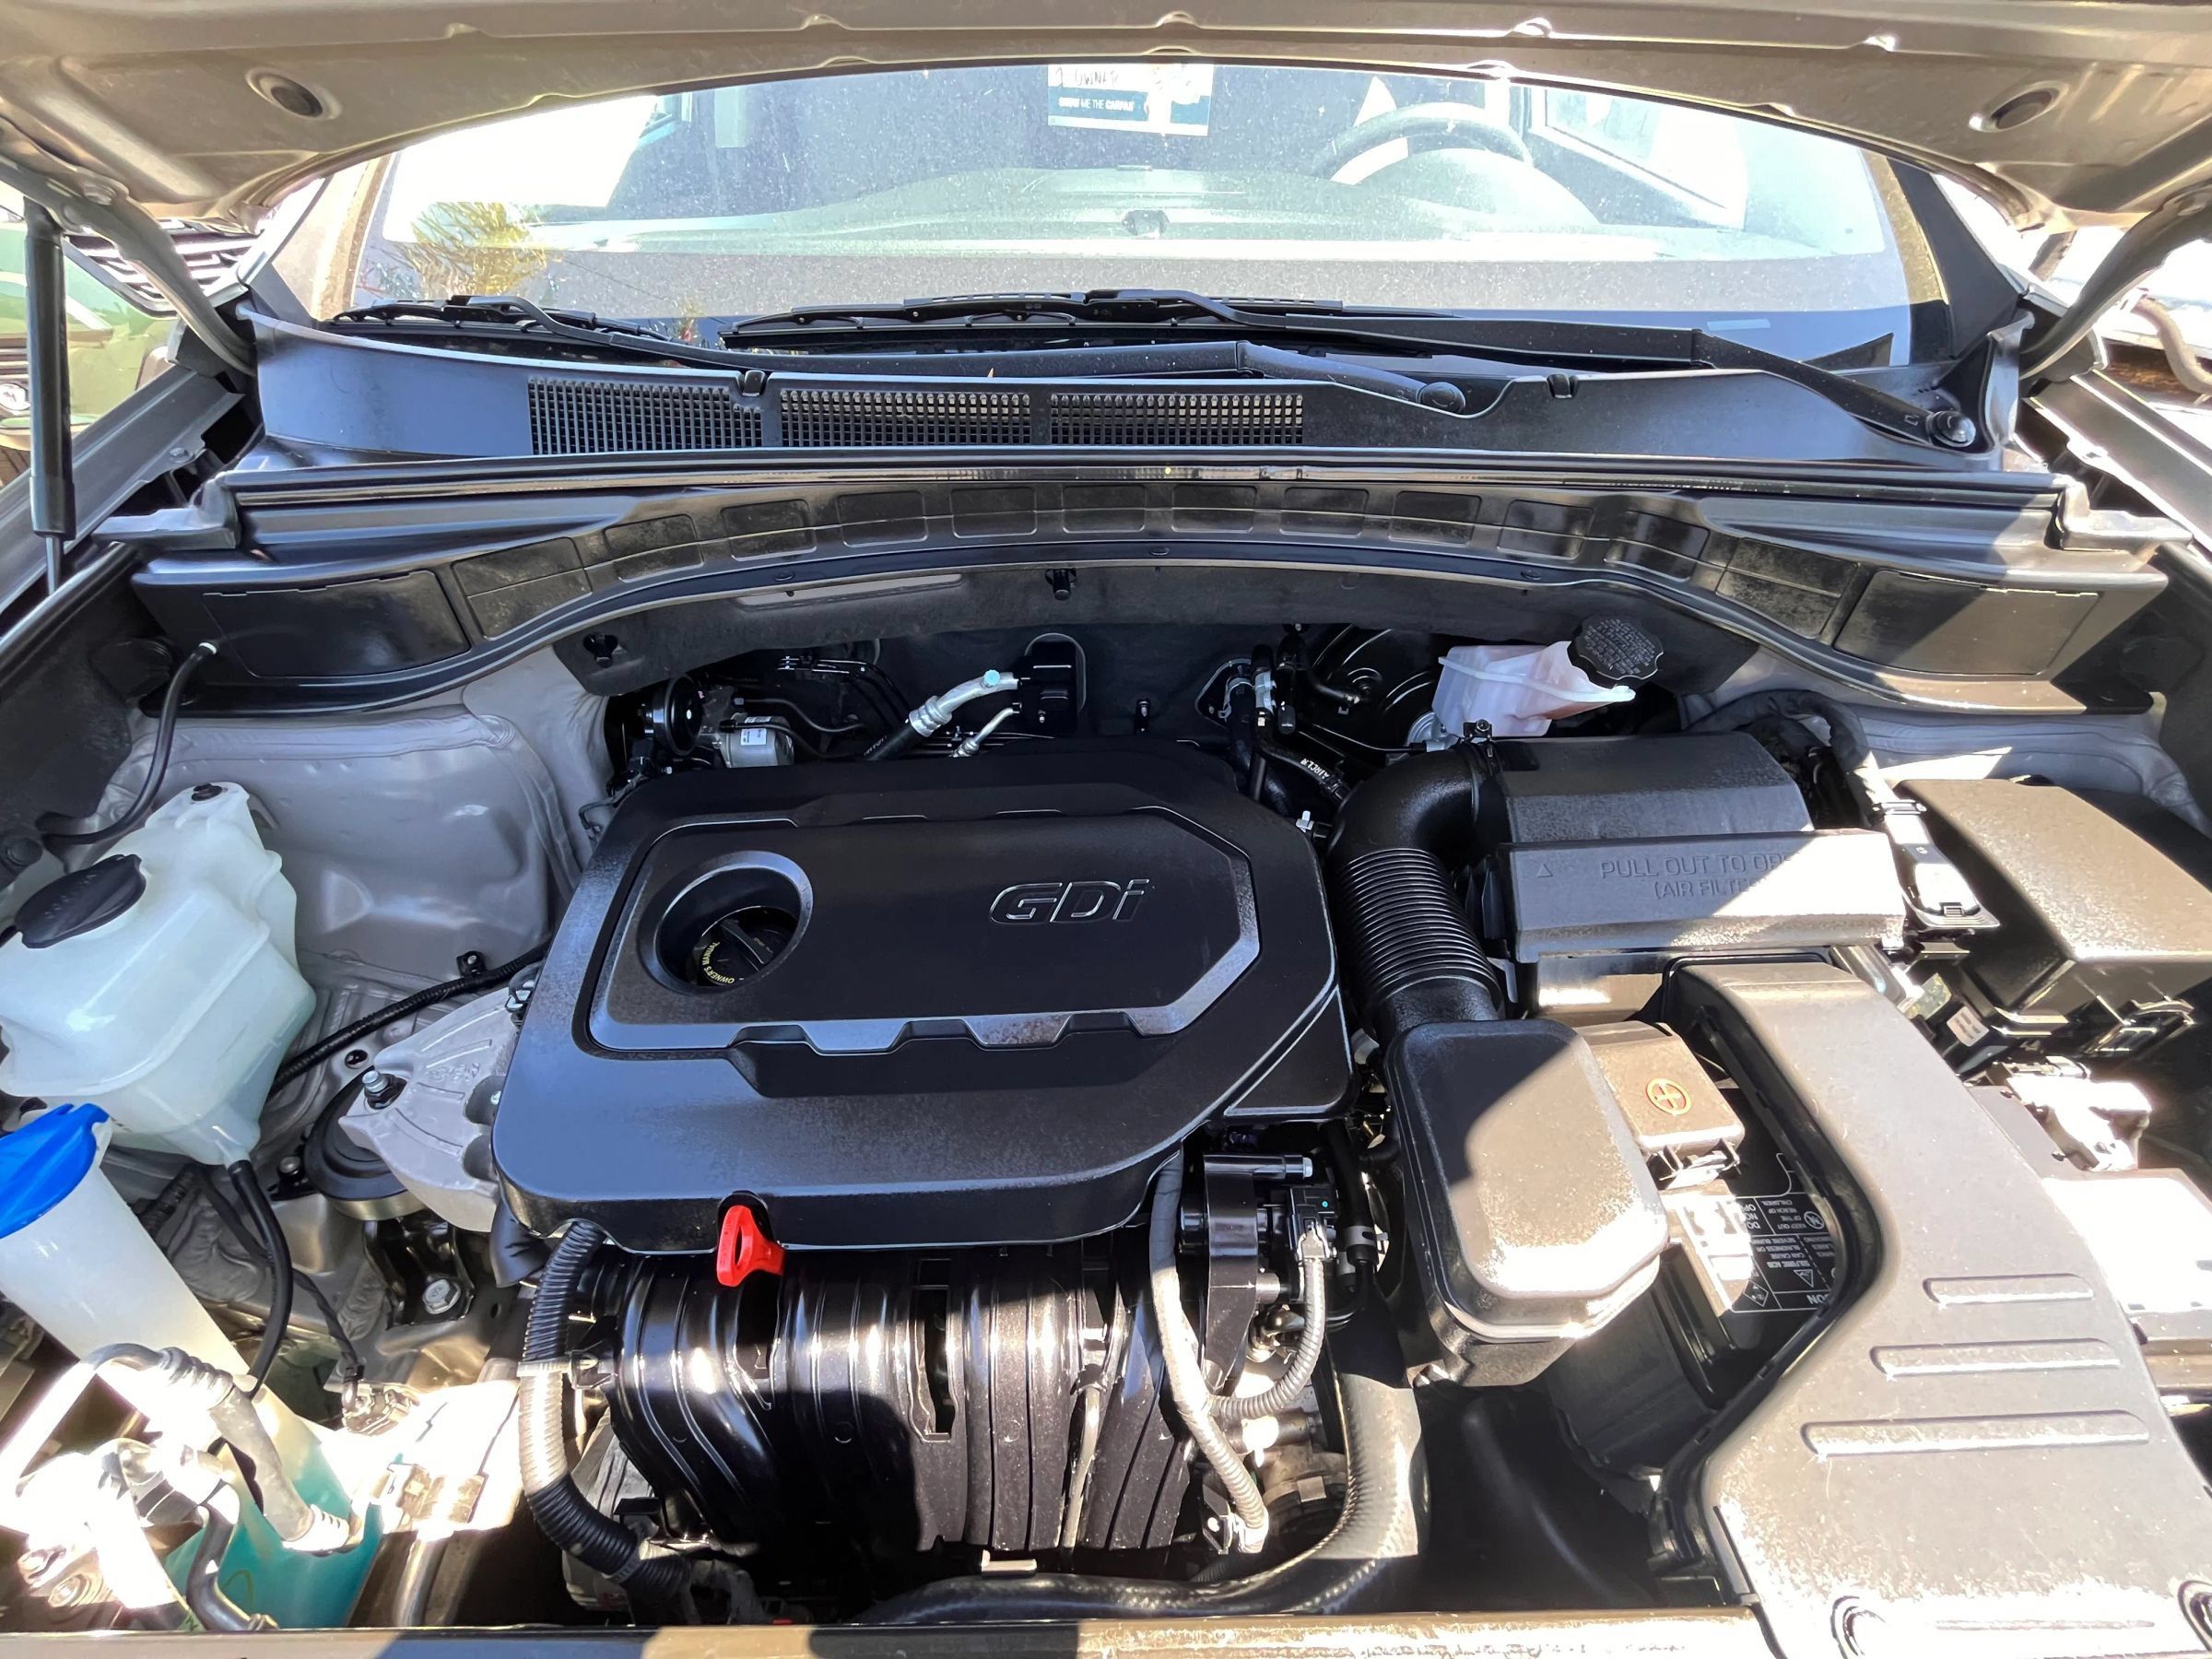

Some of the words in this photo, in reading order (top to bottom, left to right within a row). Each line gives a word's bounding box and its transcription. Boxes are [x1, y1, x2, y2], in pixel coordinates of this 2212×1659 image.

[1092, 100, 1105, 110] THE
[1599, 857, 1660, 879] PULL
[1665, 854, 1709, 877] OUT
[1714, 853, 1747, 875] TO
[989, 878, 1151, 925] GDi
[1653, 878, 1693, 901] (AIR
[701, 941, 721, 966] MANUAL
[703, 965, 735, 985] OWNER'S
